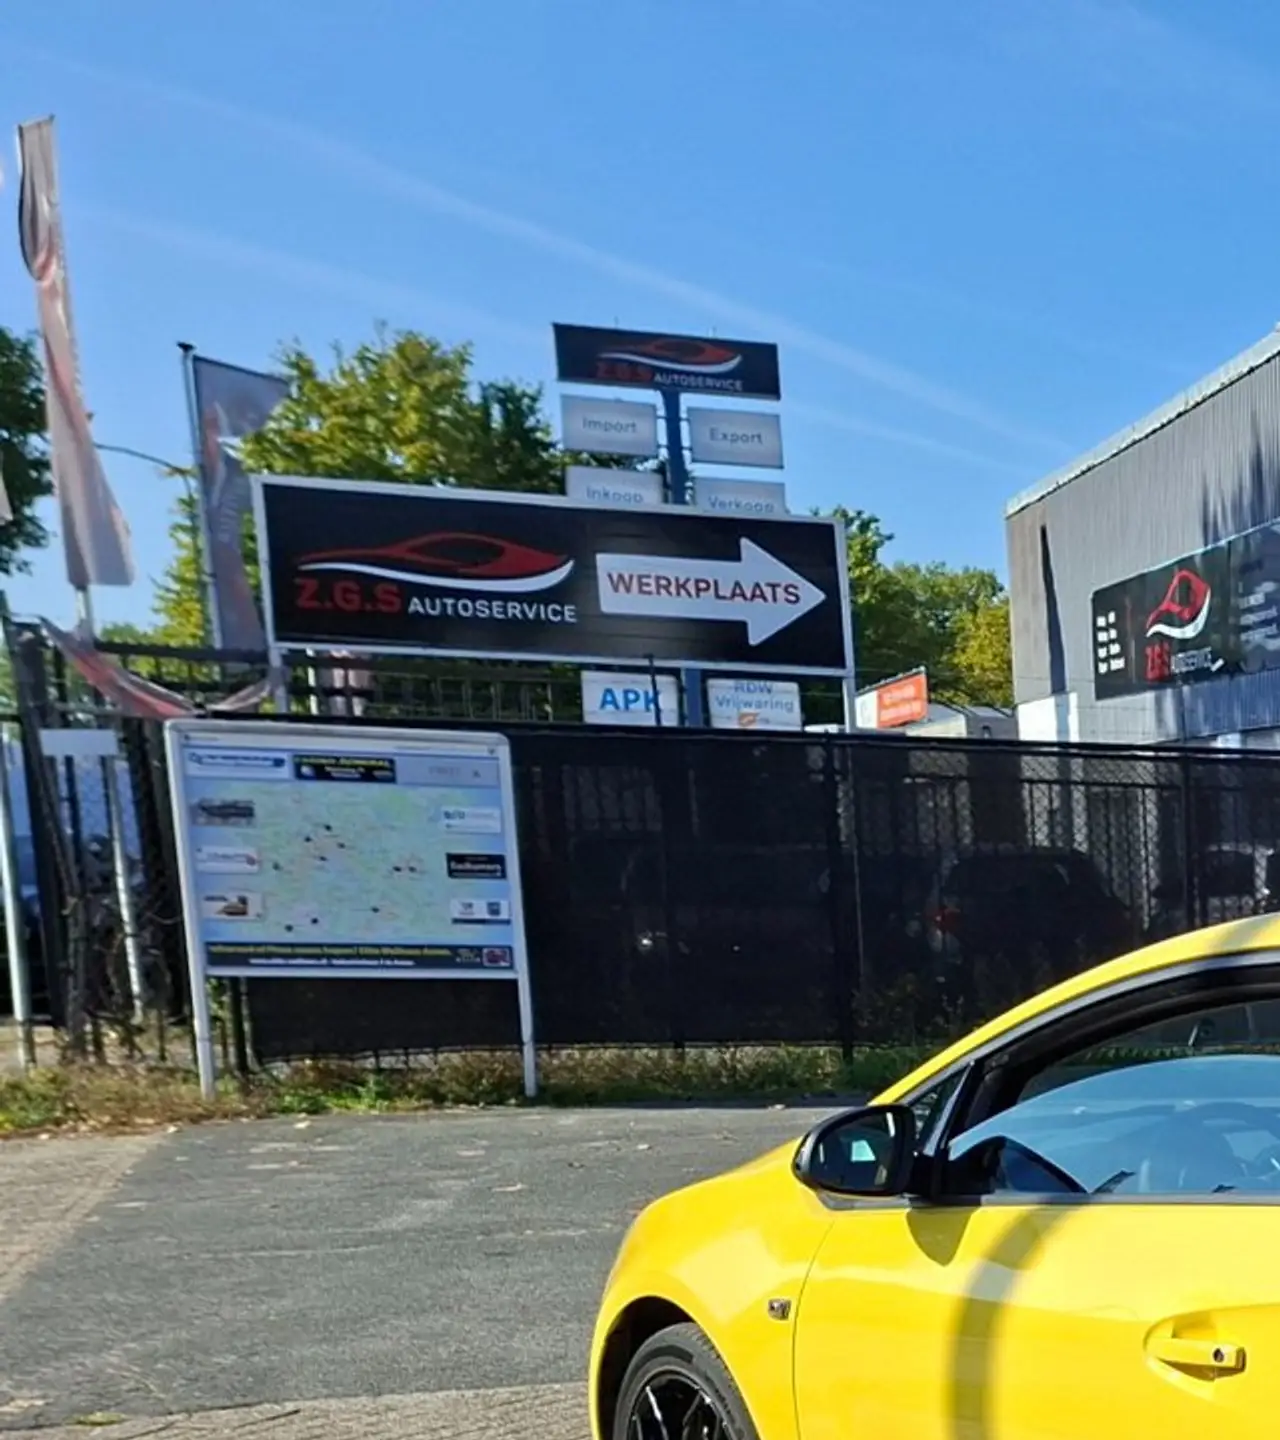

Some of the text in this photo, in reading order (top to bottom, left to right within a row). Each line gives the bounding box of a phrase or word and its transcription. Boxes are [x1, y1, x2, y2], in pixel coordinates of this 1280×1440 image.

[653, 372, 744, 392] AUTOSERVICE
[582, 416, 637, 435] Import
[709, 427, 764, 445] Export
[607, 572, 801, 605] WERKPLAATS
[295, 577, 578, 622] Z.G.S AUTOSERVICE
[600, 686, 663, 713] APK
[714, 695, 795, 713] Vrijwaring
